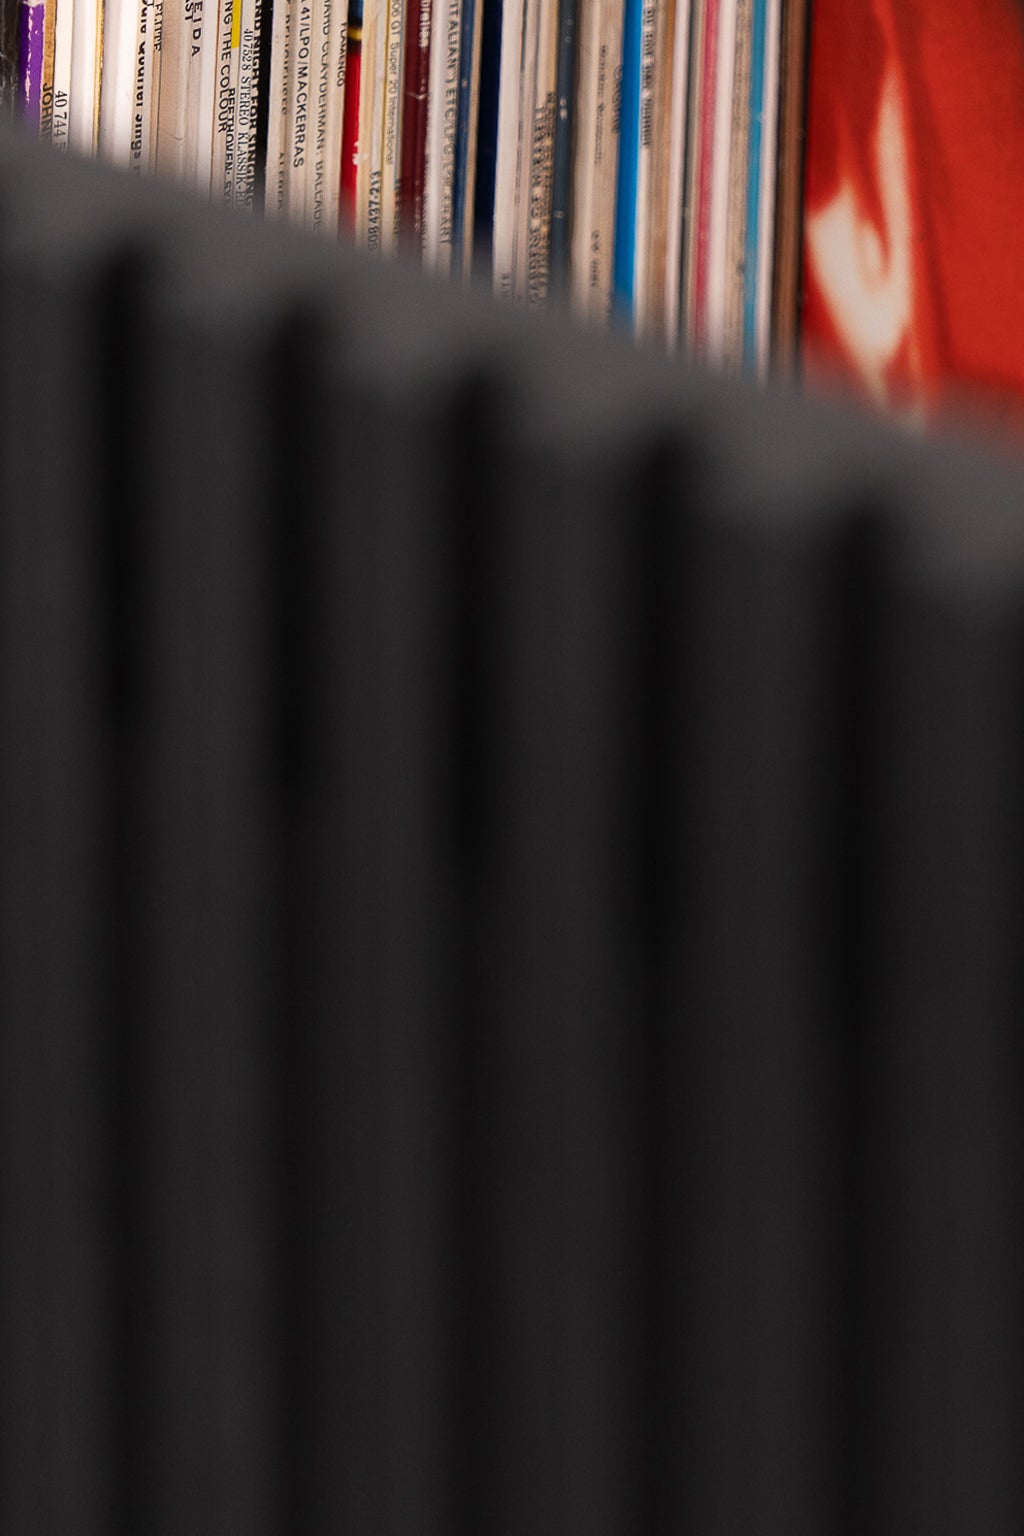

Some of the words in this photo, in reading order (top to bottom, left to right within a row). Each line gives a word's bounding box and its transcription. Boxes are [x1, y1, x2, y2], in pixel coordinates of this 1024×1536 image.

[221, 29, 234, 61] THE
[336, 21, 348, 88] FLAMENCO
[388, 41, 400, 75] Super
[54, 90, 68, 109] 40
[216, 64, 231, 134] COLOUR
[239, 75, 250, 126] STEREO
[387, 79, 398, 94] 20
[53, 111, 68, 139] 744
